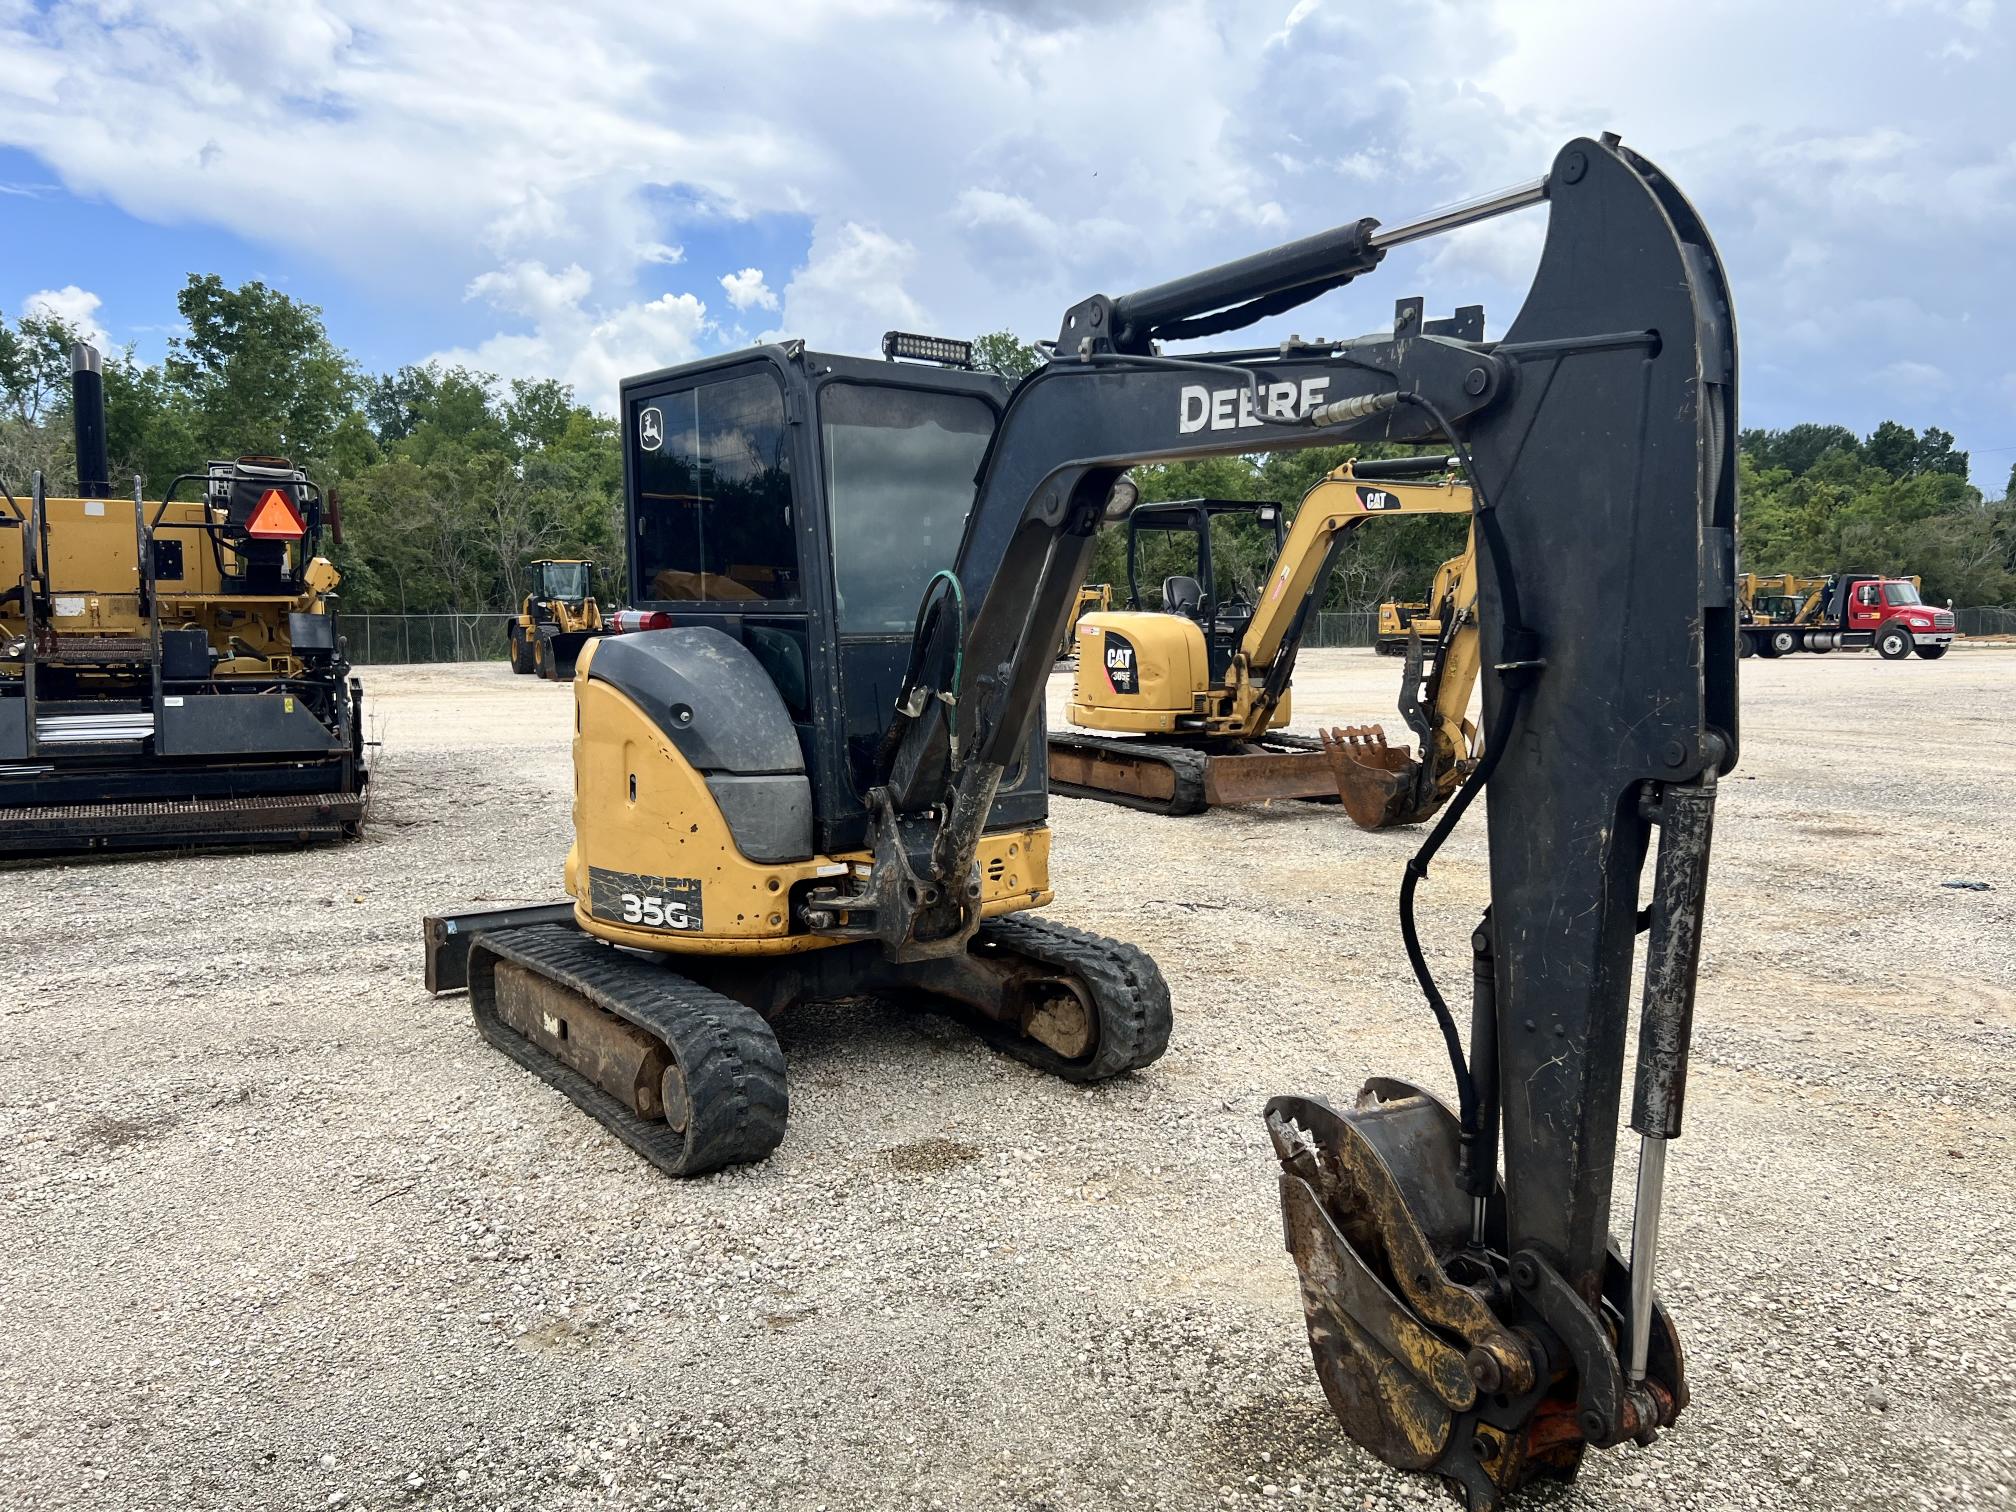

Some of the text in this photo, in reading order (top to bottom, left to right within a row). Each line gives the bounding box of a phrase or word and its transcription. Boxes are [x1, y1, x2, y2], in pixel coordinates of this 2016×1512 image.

[1366, 492, 1387, 509] CAT
[1107, 648, 1132, 669] CAT
[621, 893, 689, 929] 35G
